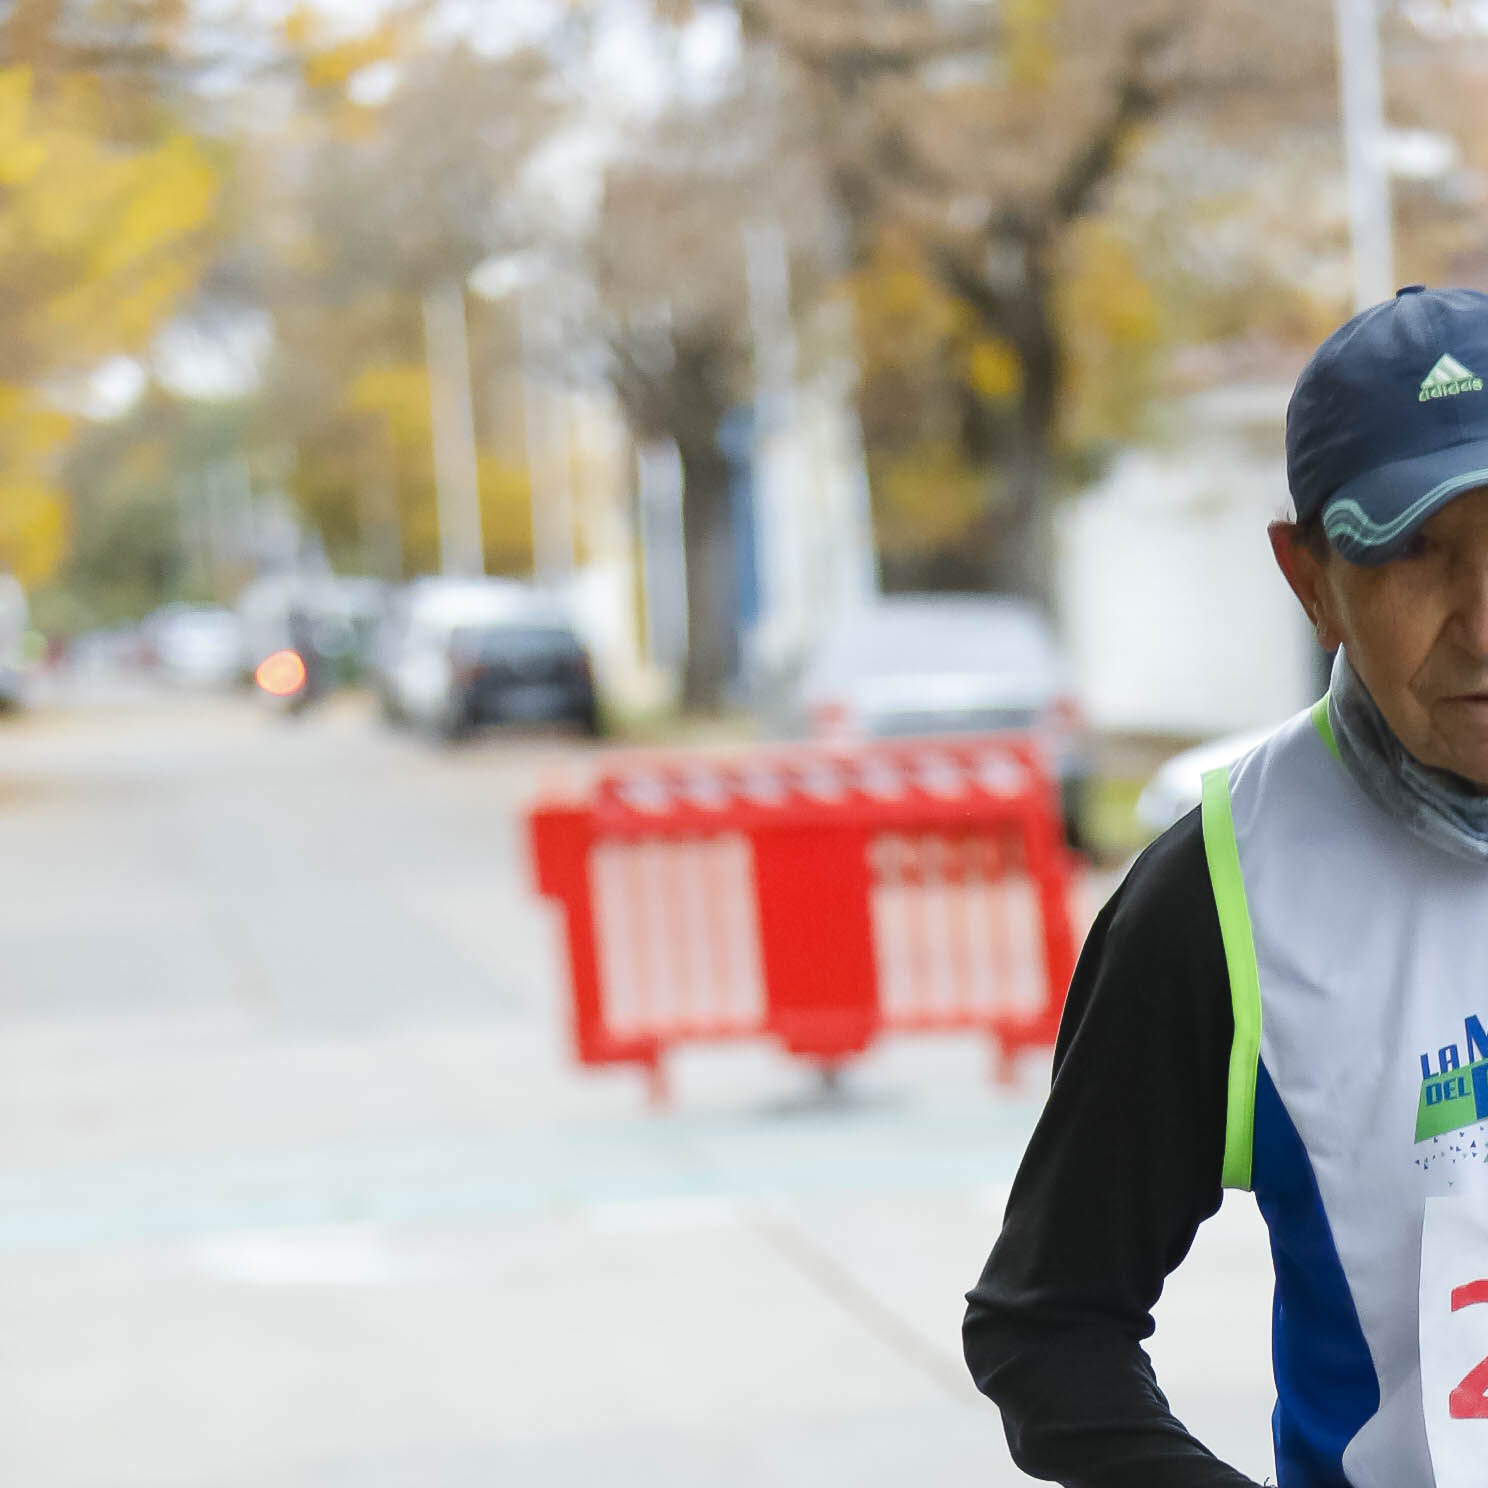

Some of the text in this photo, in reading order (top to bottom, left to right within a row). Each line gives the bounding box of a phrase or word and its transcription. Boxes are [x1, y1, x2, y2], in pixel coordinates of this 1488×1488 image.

[1419, 375, 1483, 402] adidas
[1420, 1044, 1460, 1080] LA
[1425, 1076, 1472, 1106] DEL
